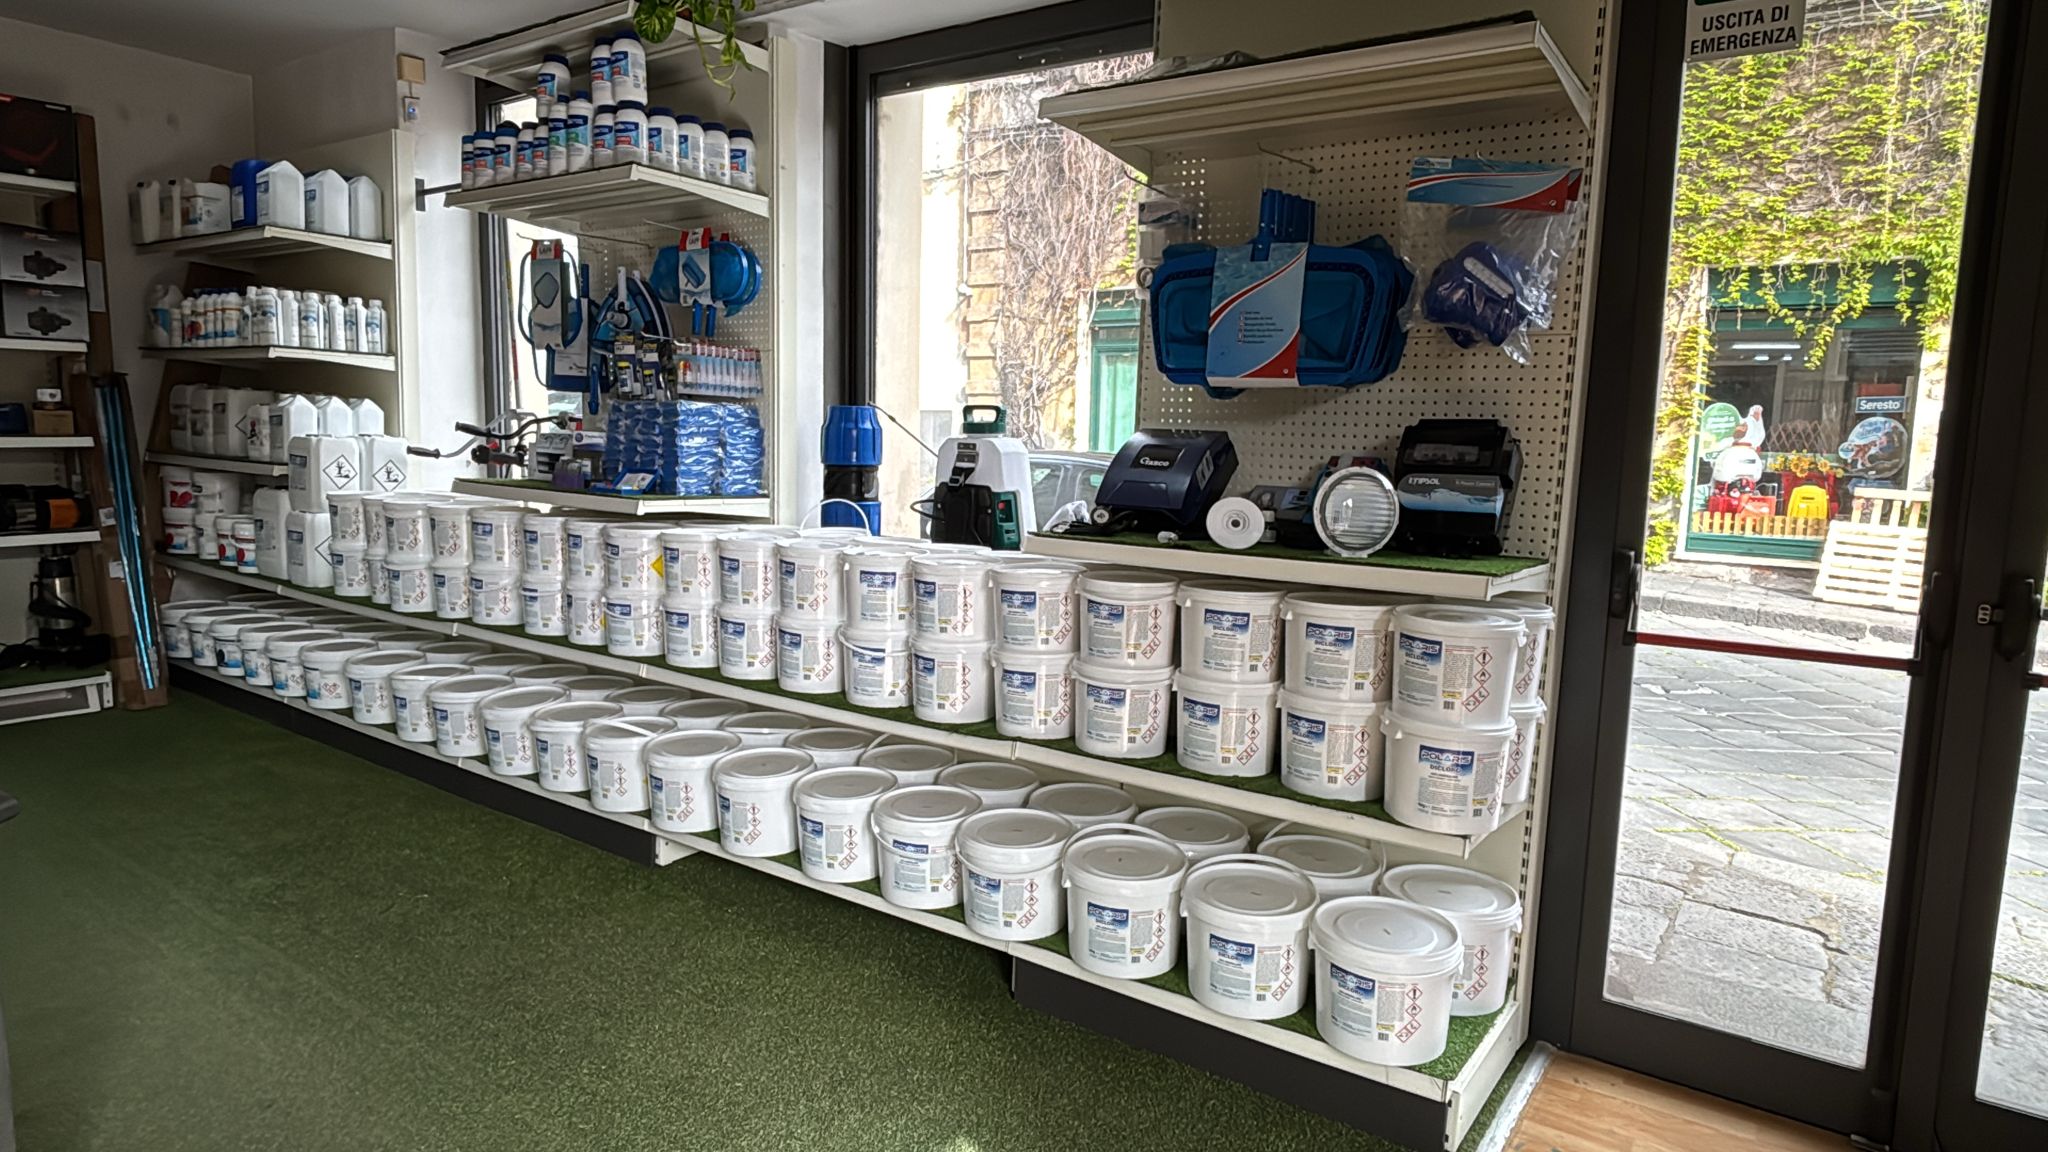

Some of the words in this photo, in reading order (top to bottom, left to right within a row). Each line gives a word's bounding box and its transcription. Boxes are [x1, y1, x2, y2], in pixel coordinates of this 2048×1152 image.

[1702, 9, 1765, 32] USCITA
[1771, 4, 1790, 23] DI
[1690, 26, 1797, 56] EMERGENZA
[1859, 400, 1901, 411] Seresto
[1421, 750, 1472, 764] POLARIS
